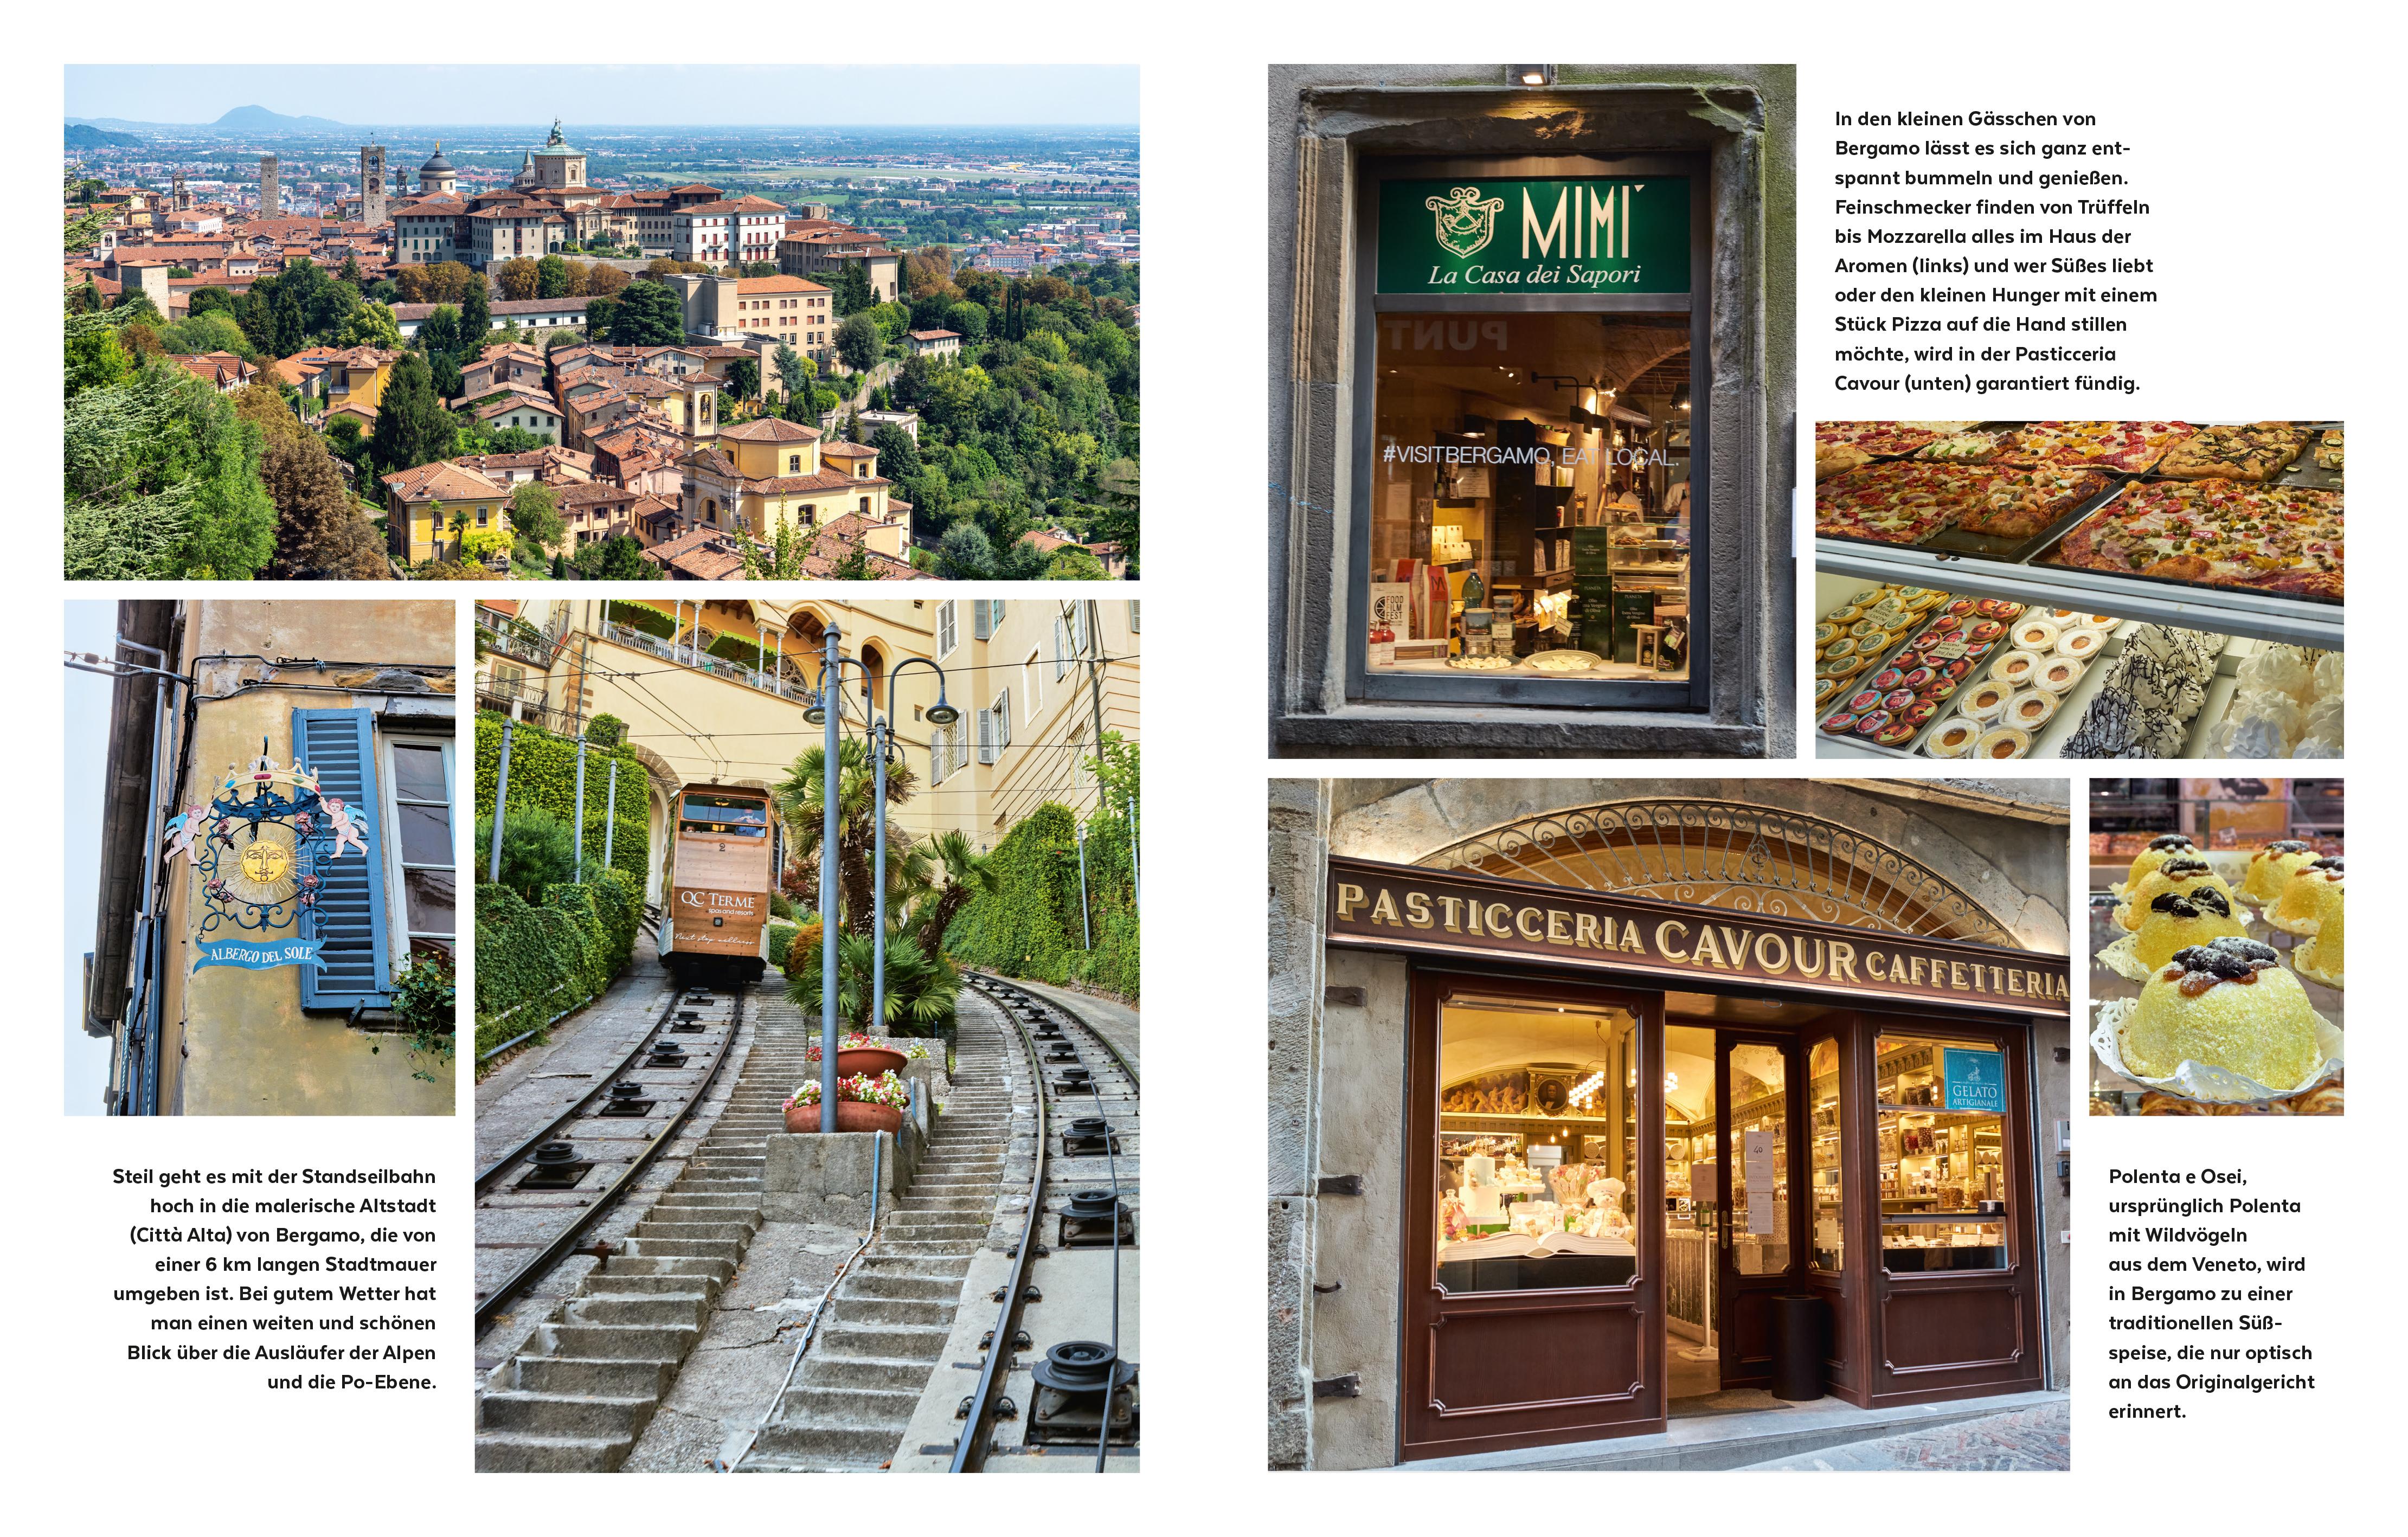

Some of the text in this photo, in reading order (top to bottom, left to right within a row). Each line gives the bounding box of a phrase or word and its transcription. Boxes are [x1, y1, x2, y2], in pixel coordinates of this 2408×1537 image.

[1428, 265, 1641, 288] La Casa dei Sapori
[1383, 445, 1679, 467] #VISITBERGAMO, EAT LOCAL.
[1386, 595, 1404, 603] FOOD
[1386, 603, 1402, 612] FILM
[1386, 612, 1403, 620] FEST
[718, 843, 726, 852] 2
[681, 891, 705, 907] QC
[675, 933, 755, 945] Next stop wellness
[1336, 883, 2070, 1002] PASTICCERIA CAVOUR CAFFETTERIA
[211, 947, 313, 963] ALBERGO DEL SOLE
[1953, 1085, 1998, 1098] GELATO
[1953, 1098, 1999, 1107] ARTIGIANALE
